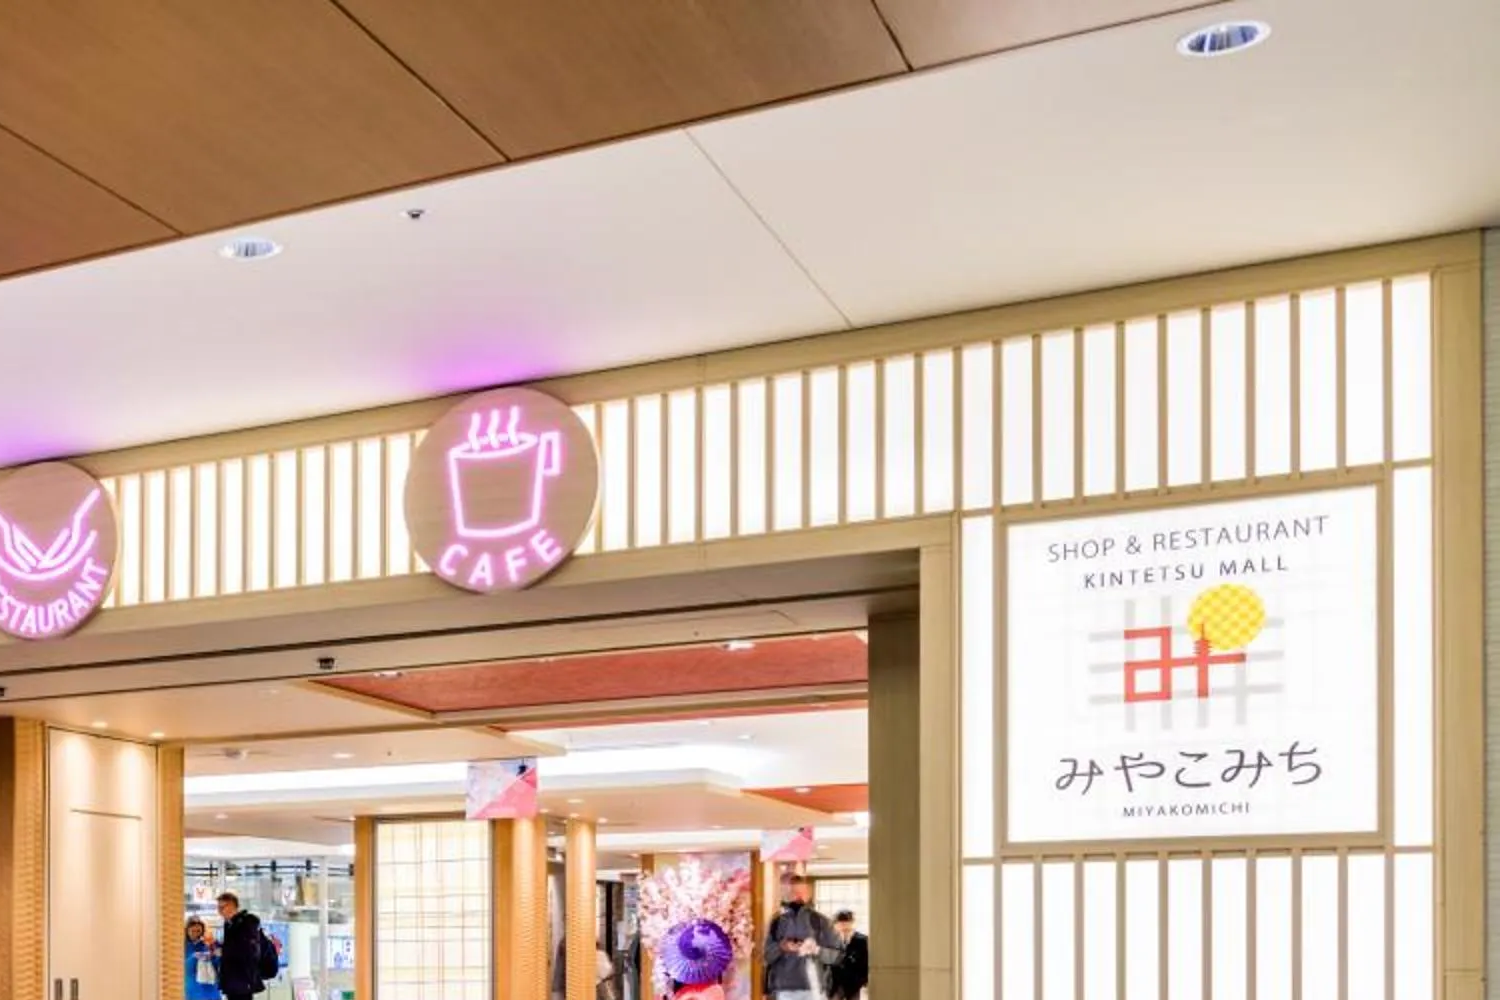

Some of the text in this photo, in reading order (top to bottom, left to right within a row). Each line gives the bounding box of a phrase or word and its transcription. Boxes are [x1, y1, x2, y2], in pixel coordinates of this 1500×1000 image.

[439, 529, 563, 586] CAFE
[1047, 514, 1331, 563] SHOP & RESTAURANT
[1084, 555, 1290, 590] KINTETSU MALL
[1055, 740, 1322, 796] みやこみち
[1122, 801, 1251, 819] MIYAKOMICHI
